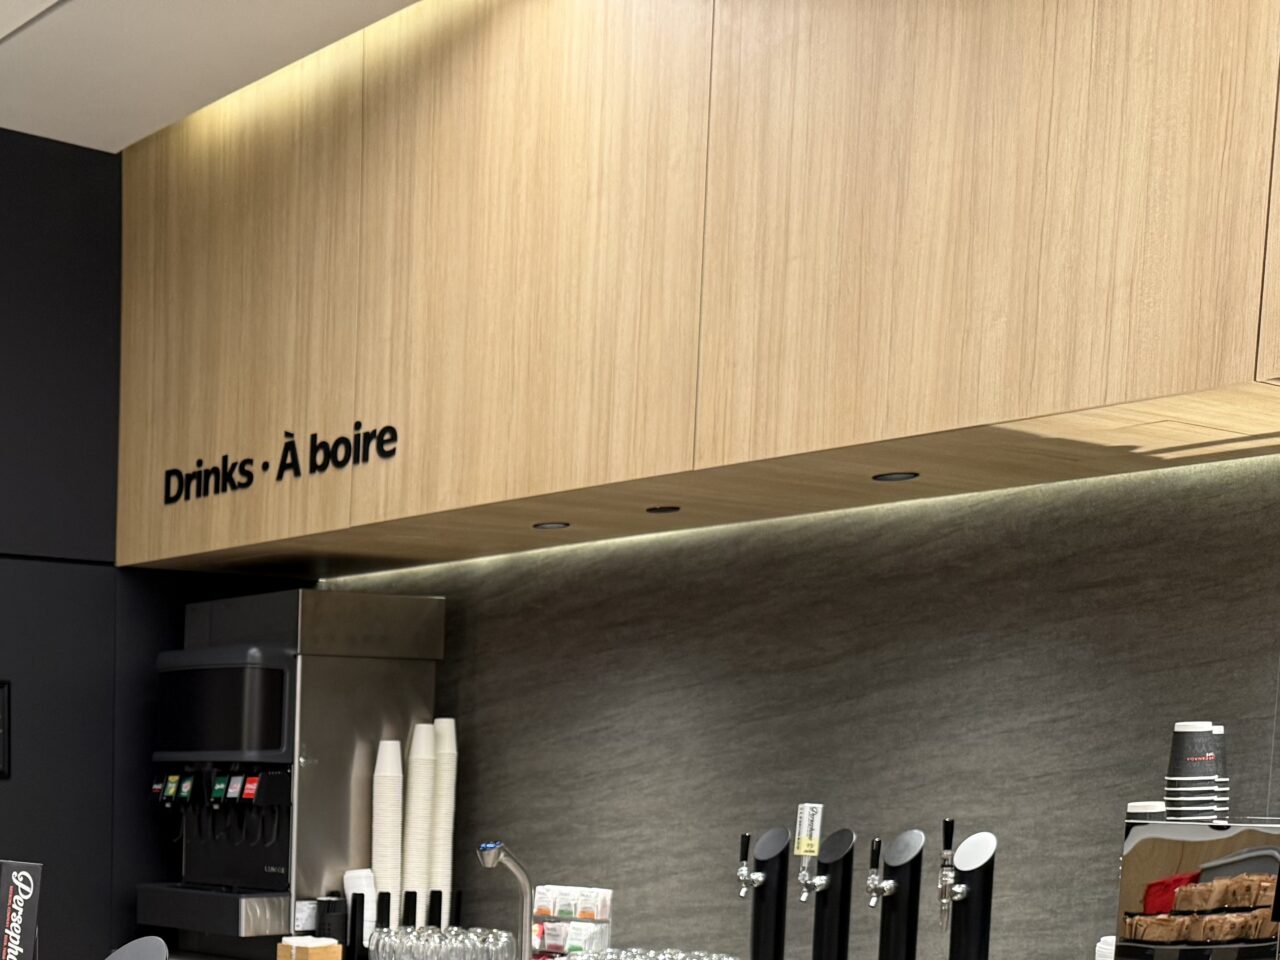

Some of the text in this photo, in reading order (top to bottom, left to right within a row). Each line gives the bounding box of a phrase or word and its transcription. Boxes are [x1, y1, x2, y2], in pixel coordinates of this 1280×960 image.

[164, 455, 254, 505] Drinks
[276, 431, 301, 481] À
[309, 421, 397, 474] boire
